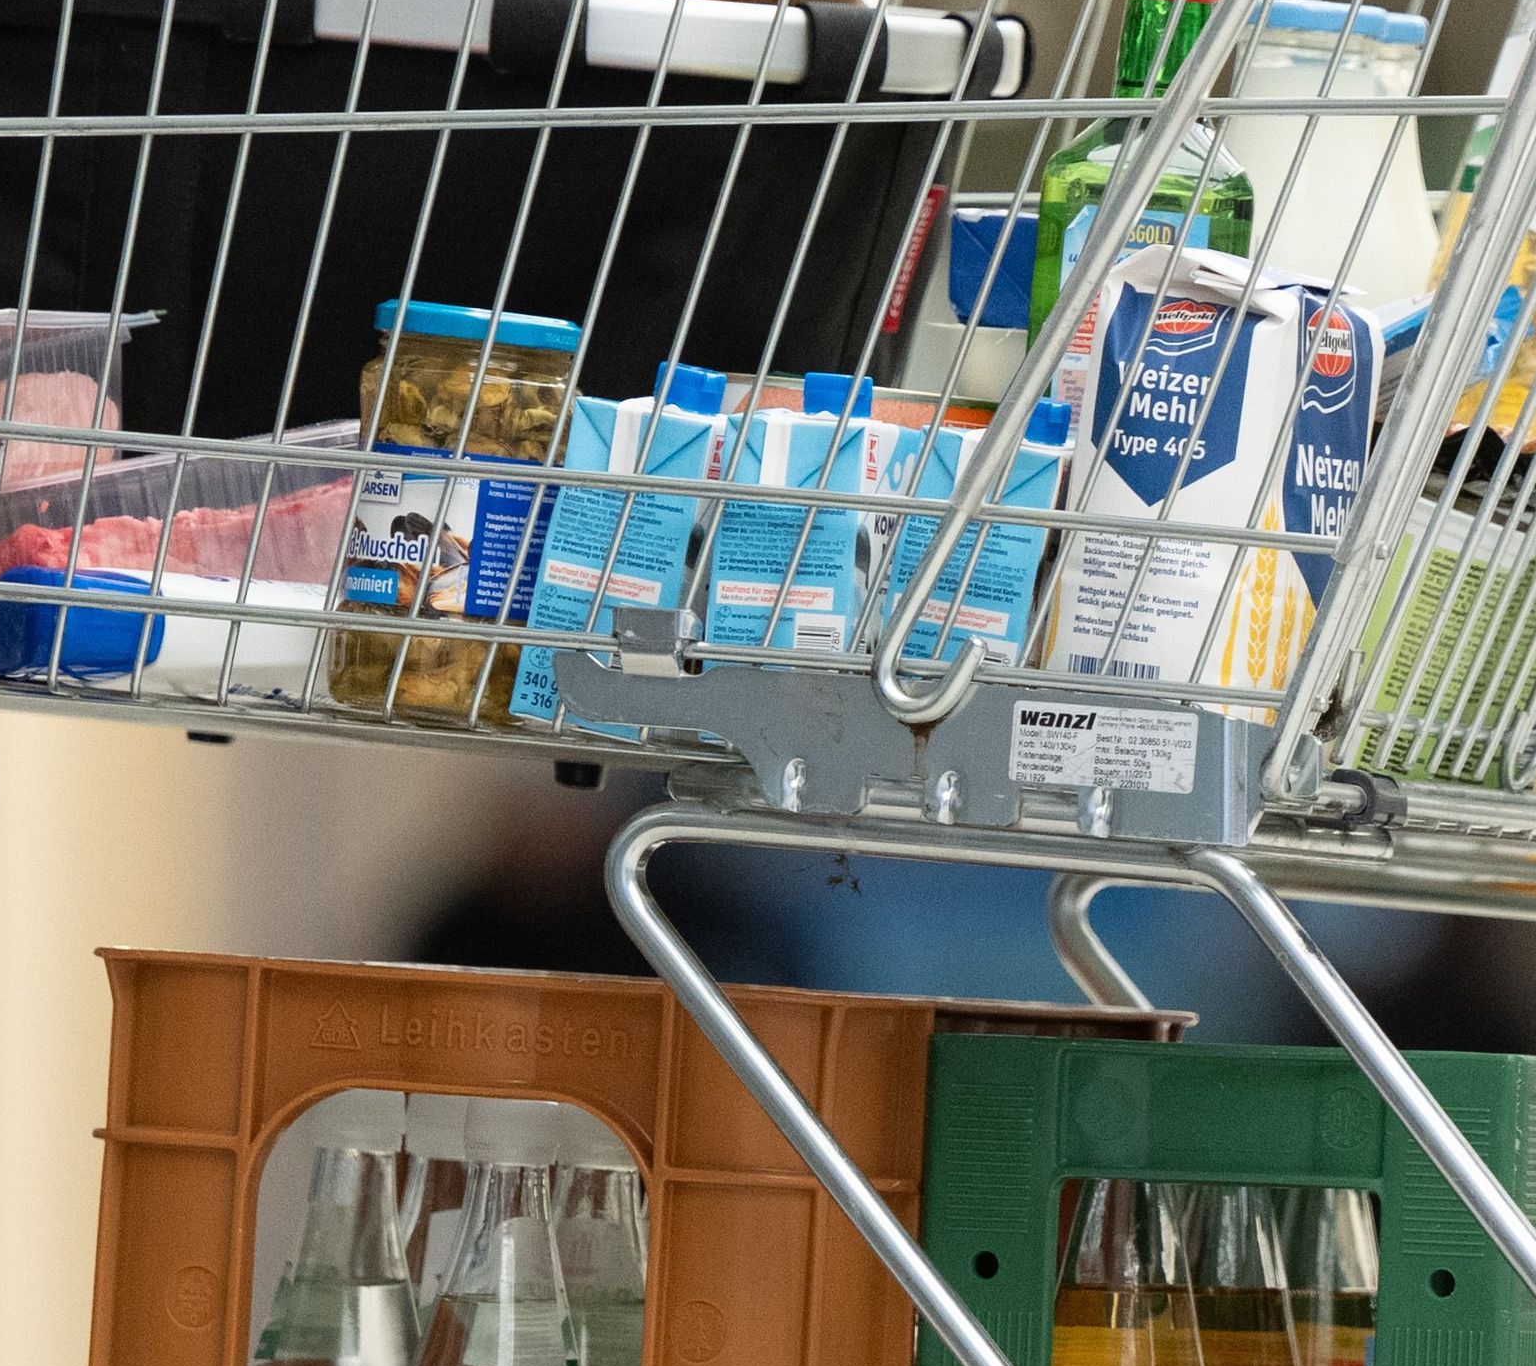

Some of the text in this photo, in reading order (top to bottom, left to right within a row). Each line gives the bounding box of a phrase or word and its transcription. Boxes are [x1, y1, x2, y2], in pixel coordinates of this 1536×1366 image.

[1129, 392, 1197, 426] Mehl
[1114, 429, 1157, 456] Type
[361, 482, 398, 498] ARSEN
[1195, 550, 1211, 559] und
[1108, 560, 1122, 569] und
[1179, 569, 1200, 579] Back-
[1181, 559, 1208, 570] gleich-
[1152, 596, 1182, 607] Kuchen
[1183, 600, 1199, 609] und
[1156, 607, 1194, 619] geeignet.
[1142, 623, 1157, 634] bis:
[523, 671, 558, 695] 340 g
[530, 691, 553, 709] 316
[1020, 710, 1096, 730] wanzl
[1133, 759, 1150, 768] 50kg
[1016, 772, 1045, 782] EN 1929
[1119, 780, 1149, 790] 2231012
[380, 1003, 631, 1057] Leihkasten
